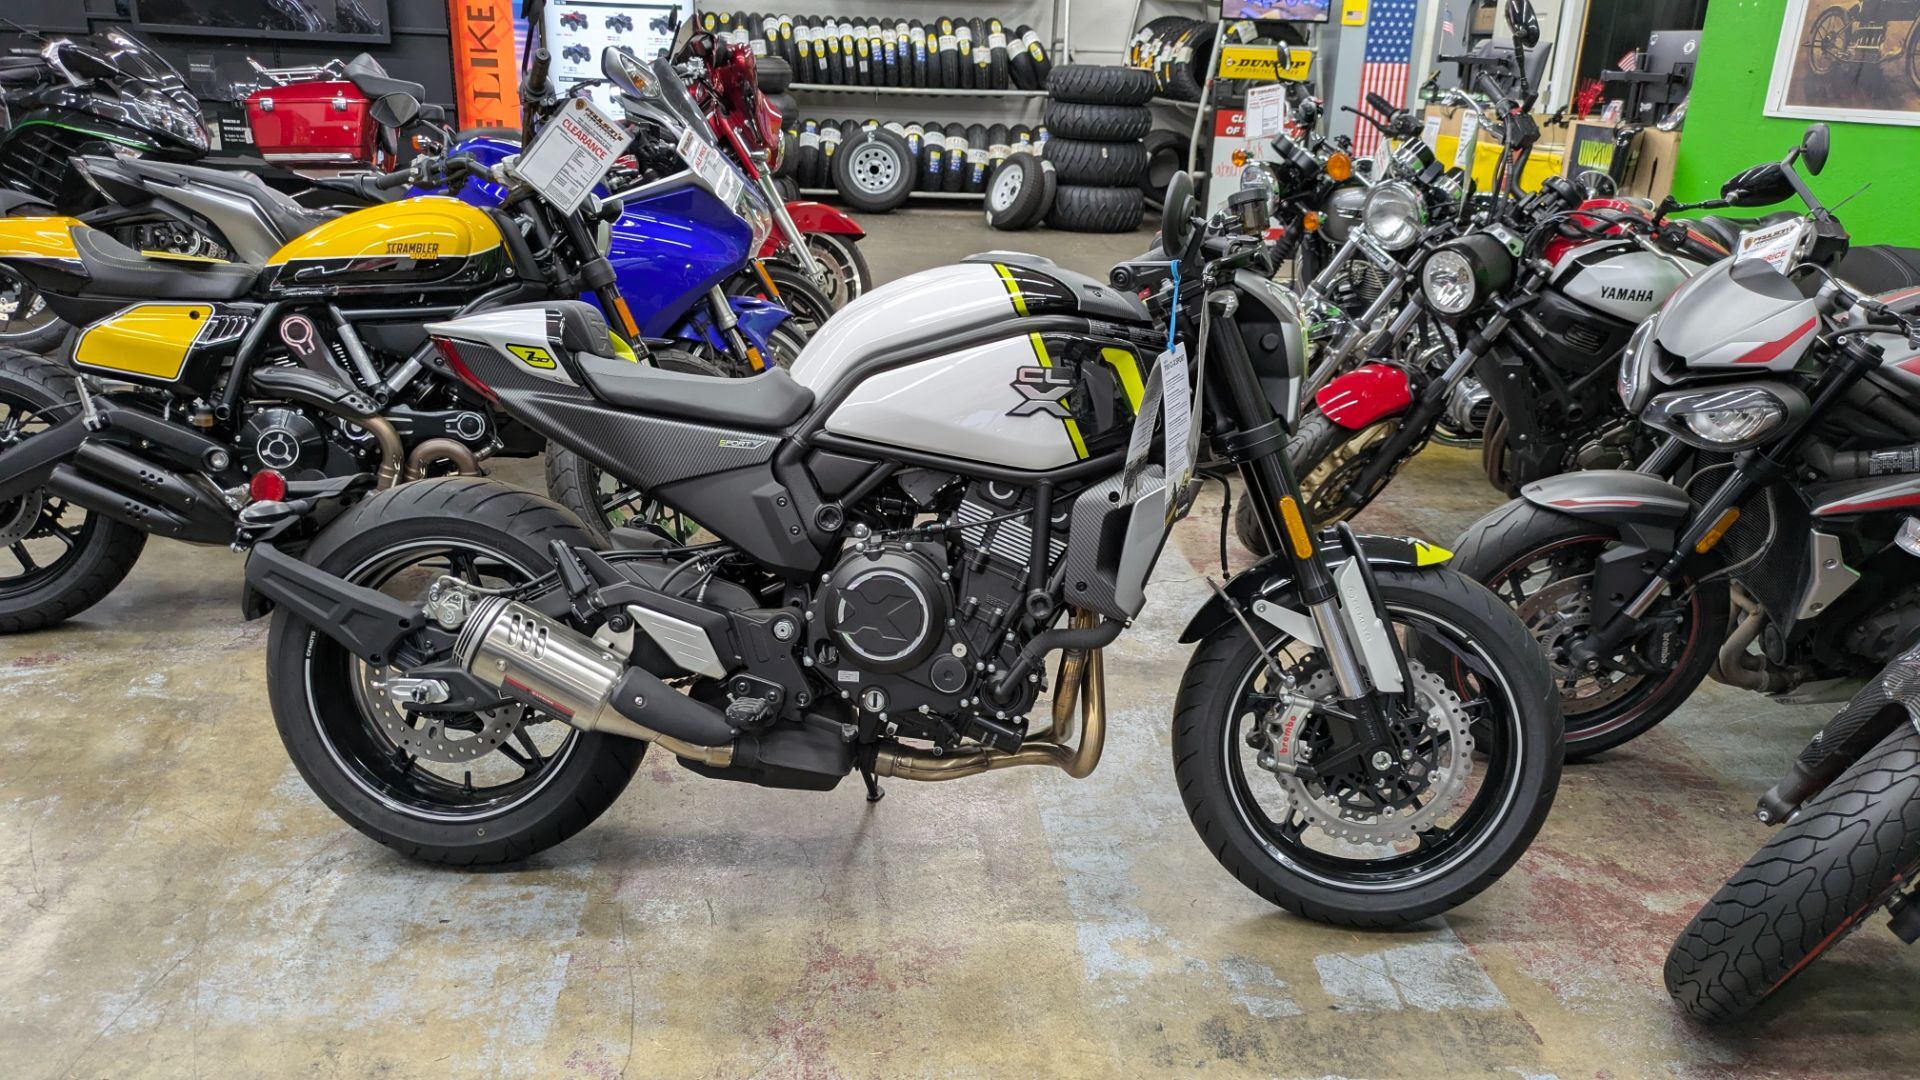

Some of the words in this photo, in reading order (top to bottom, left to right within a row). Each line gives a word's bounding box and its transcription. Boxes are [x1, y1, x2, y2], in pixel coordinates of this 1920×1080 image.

[466, 5, 502, 104] LIKE
[1237, 59, 1305, 68] DUNP
[1225, 126, 1240, 135] OF
[562, 118, 608, 161] CLEARANCE
[386, 243, 439, 254] SCRAMBLER
[1601, 286, 1654, 302] YAMAHA
[524, 350, 551, 363] 700
[719, 439, 752, 448] SPORT
[1660, 632, 1673, 664] brembo
[1279, 715, 1297, 754] brembo
